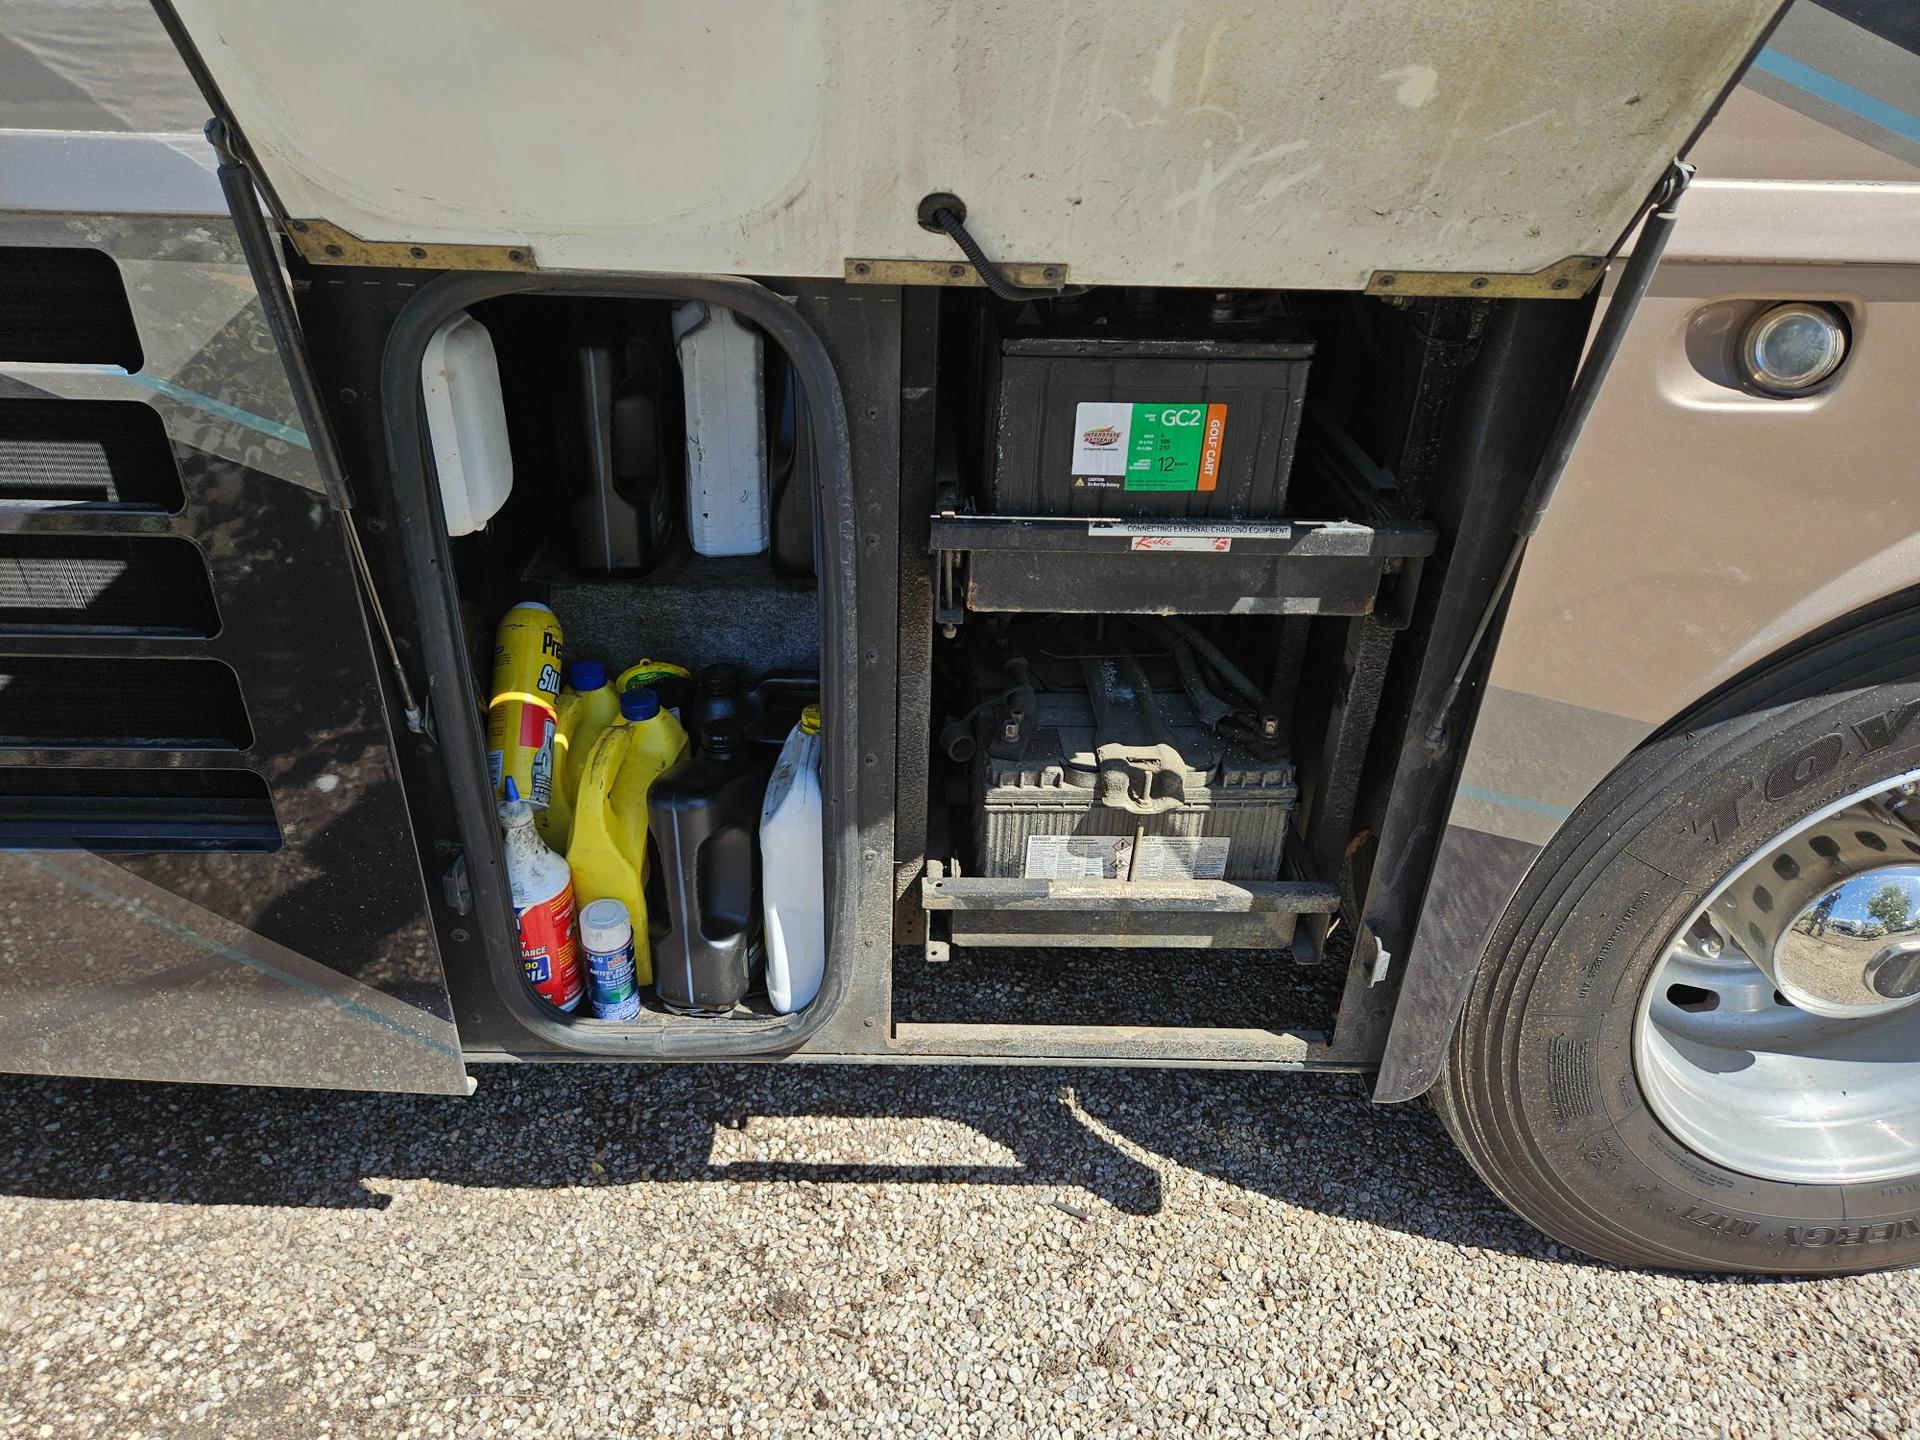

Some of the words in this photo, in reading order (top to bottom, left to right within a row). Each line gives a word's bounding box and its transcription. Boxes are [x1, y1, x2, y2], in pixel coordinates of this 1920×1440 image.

[1161, 409, 1201, 426] GC2
[1210, 419, 1220, 448] GOLF
[1158, 456, 1175, 472] 12
[1204, 450, 1216, 476] CART
[1127, 525, 1172, 533] CONNECTING
[1173, 525, 1208, 533] EXTERNAL
[1211, 526, 1248, 534] CHARGING
[1249, 526, 1289, 535] EQUIPMENT
[524, 961, 539, 970] 90
